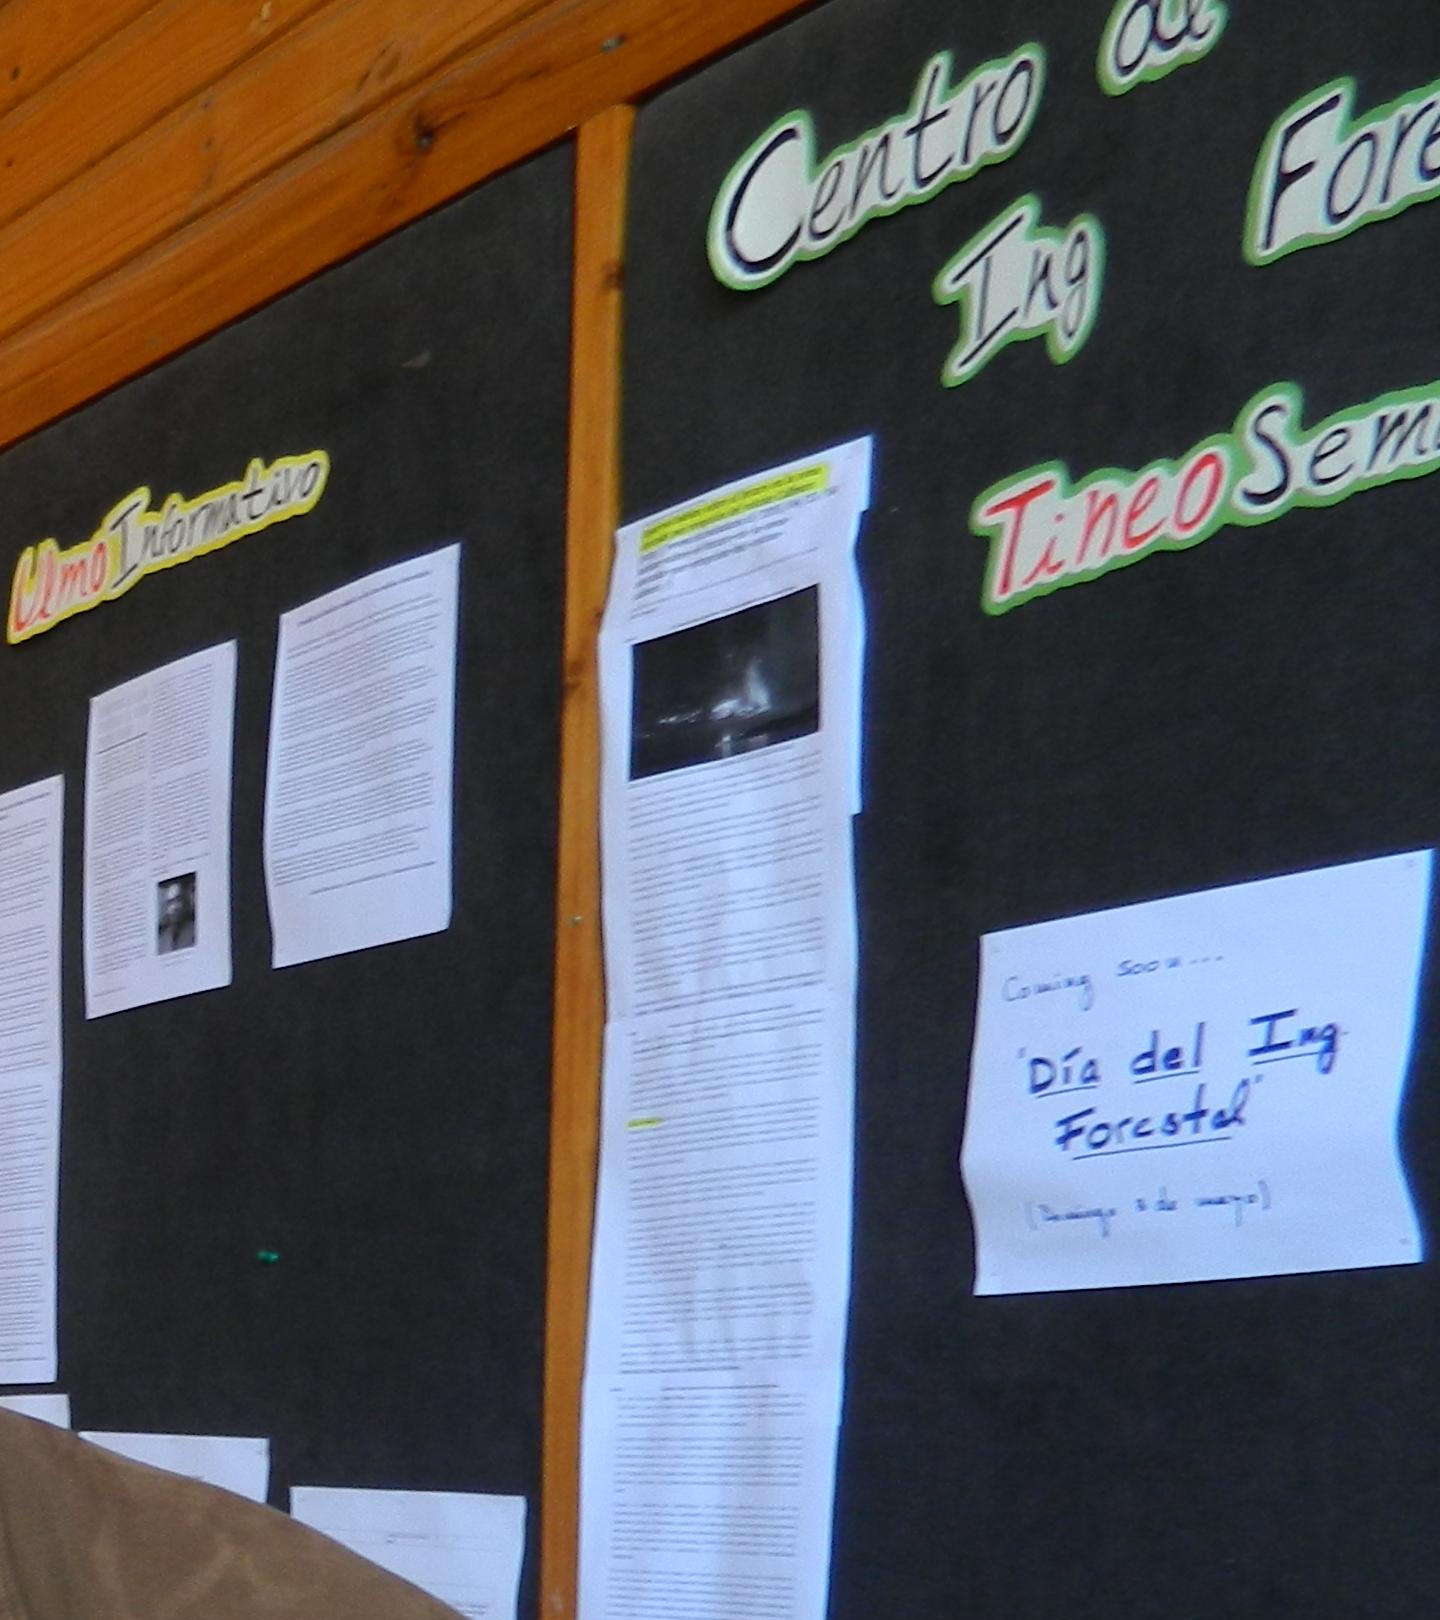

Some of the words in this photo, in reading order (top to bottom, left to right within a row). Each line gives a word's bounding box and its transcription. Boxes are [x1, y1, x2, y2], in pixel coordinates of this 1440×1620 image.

[724, 56, 1037, 274] Centro
[951, 213, 1090, 369] Ing
[109, 462, 319, 590] Informativo
[985, 452, 1223, 595] Tineo
[1241, 403, 1440, 505] Sem
[1002, 974, 1096, 1012] Coming
[1130, 1021, 1207, 1076] del
